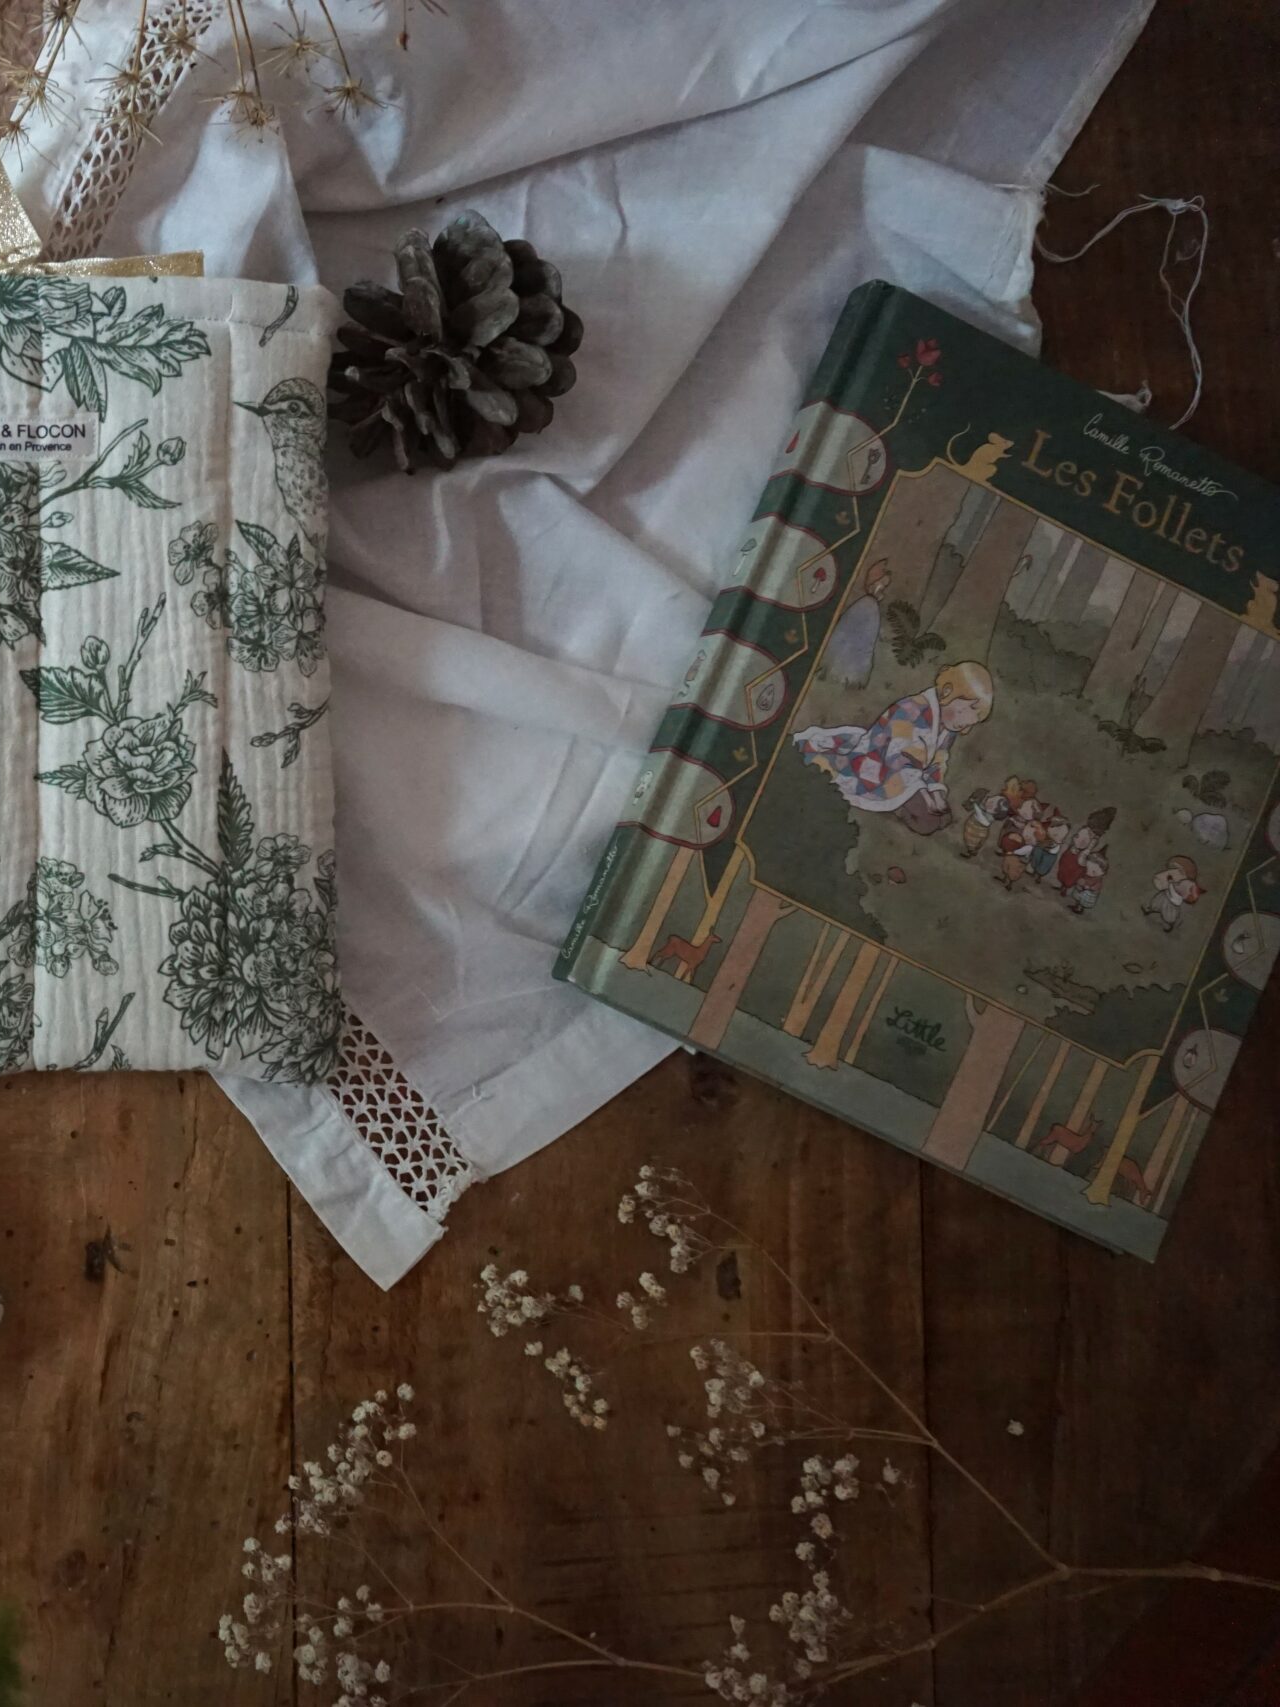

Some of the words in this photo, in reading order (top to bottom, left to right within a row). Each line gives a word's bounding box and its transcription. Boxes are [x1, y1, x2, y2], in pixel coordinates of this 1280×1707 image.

[1, 424, 12, 438] &
[17, 424, 86, 439] FLOCON
[9, 443, 22, 451] en
[25, 441, 73, 452] Provence
[1082, 413, 1130, 455] Camille
[1021, 429, 1097, 497] Les
[1102, 470, 1245, 573] Follets
[886, 1006, 947, 1052] Little
